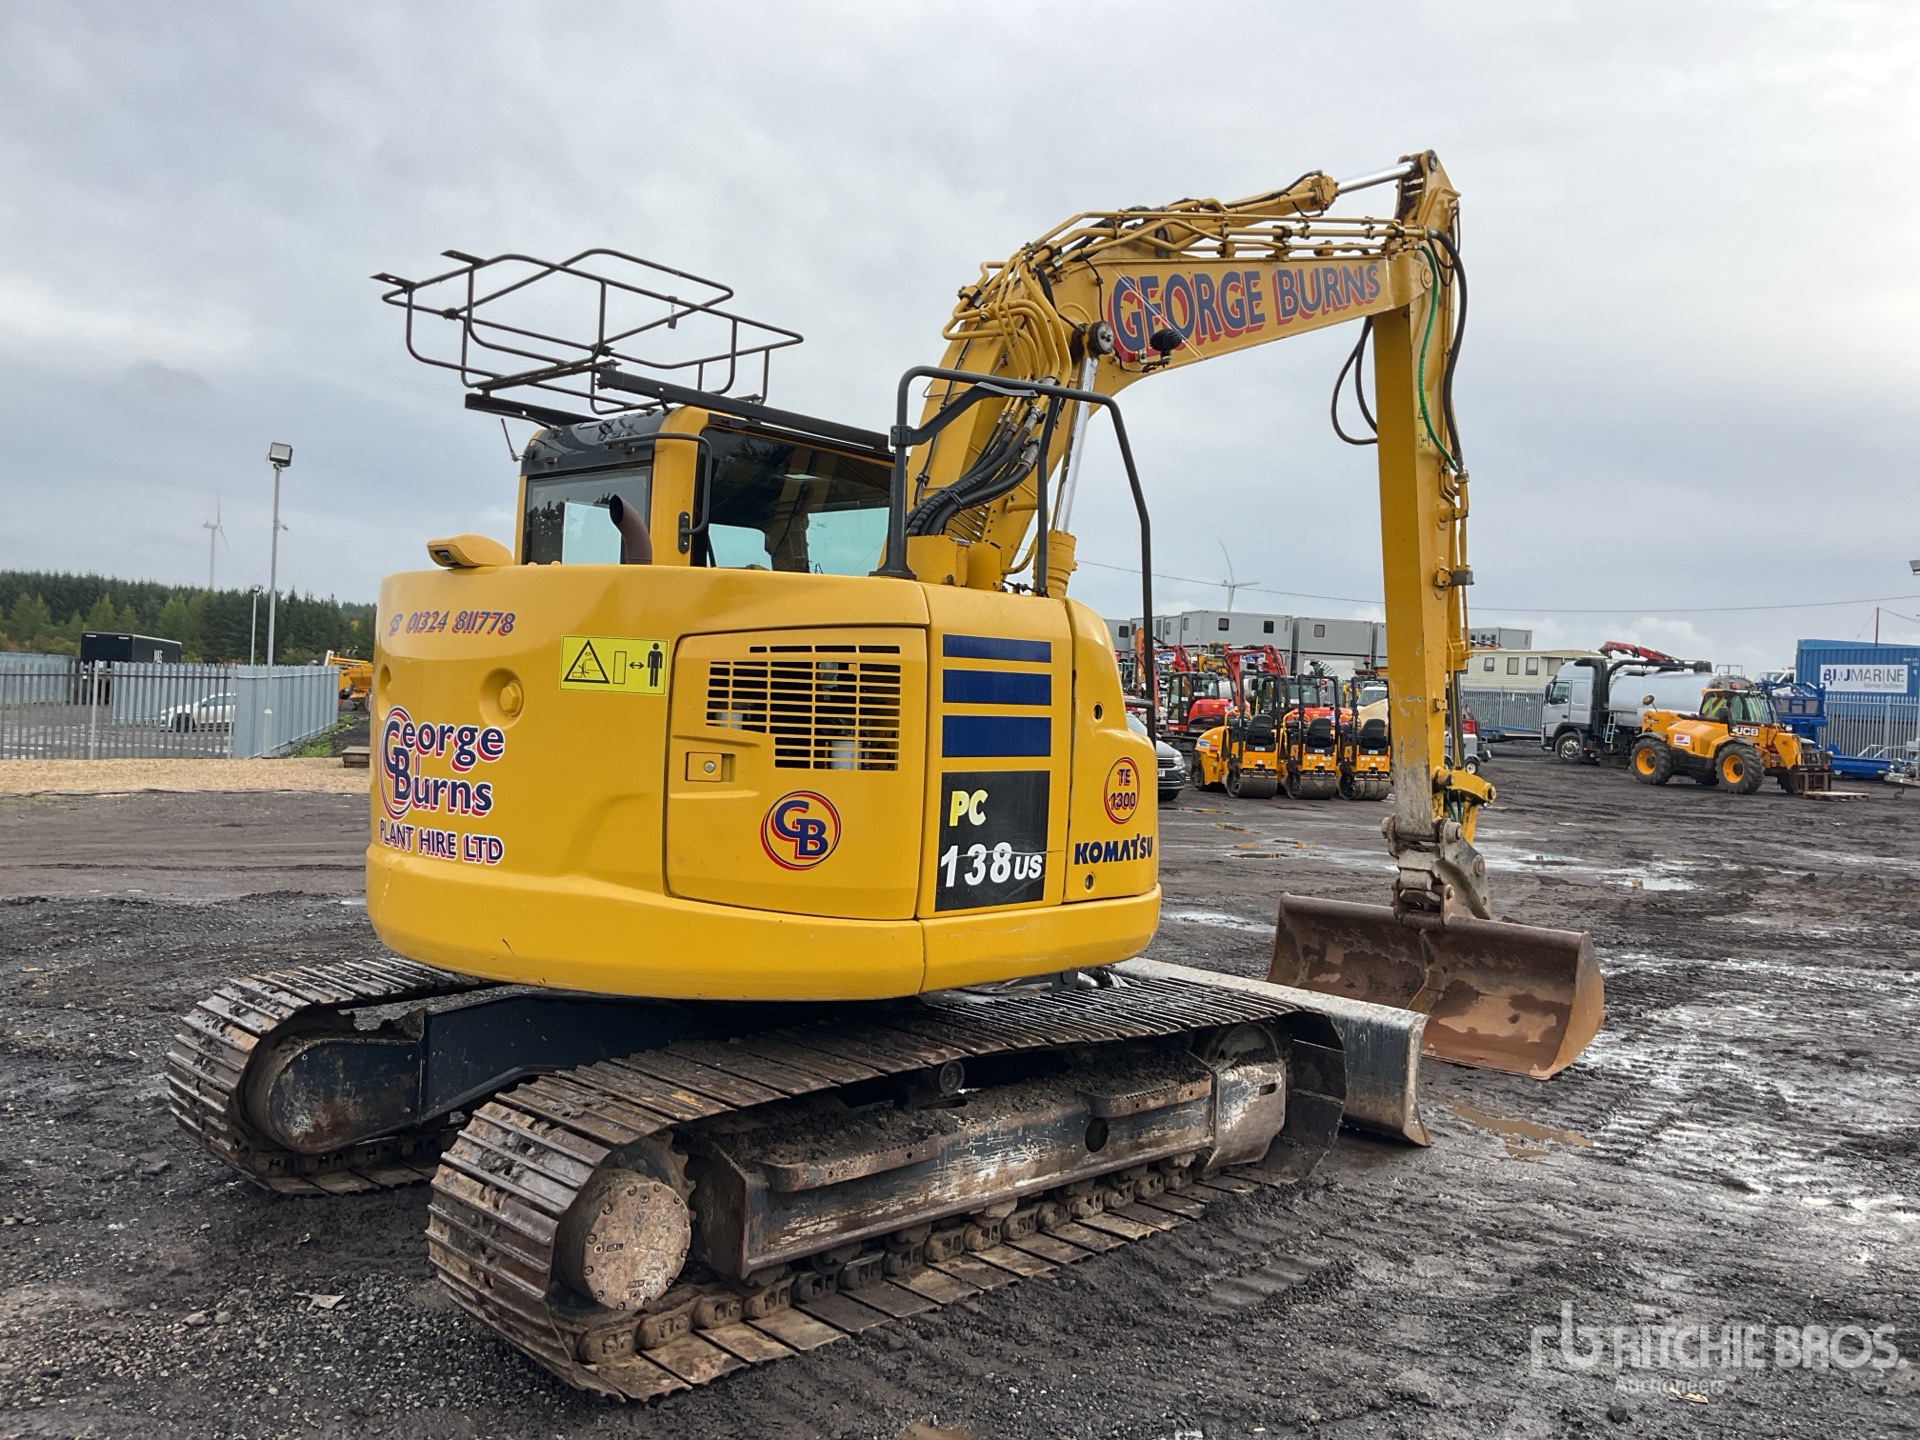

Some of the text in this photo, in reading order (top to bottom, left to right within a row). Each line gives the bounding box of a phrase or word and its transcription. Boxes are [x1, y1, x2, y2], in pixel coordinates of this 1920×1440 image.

[1108, 264, 1382, 363] GEORGE BURNS
[405, 610, 516, 637] 01324 811778
[384, 717, 505, 775] George
[1735, 726, 1759, 736] JCB
[388, 745, 494, 818] Burns
[1117, 768, 1132, 787] TE
[949, 790, 988, 827] PC
[1108, 791, 1136, 811] 1300
[379, 818, 504, 865] PLANT HIRE LTD
[1074, 832, 1154, 866] KOMATSU
